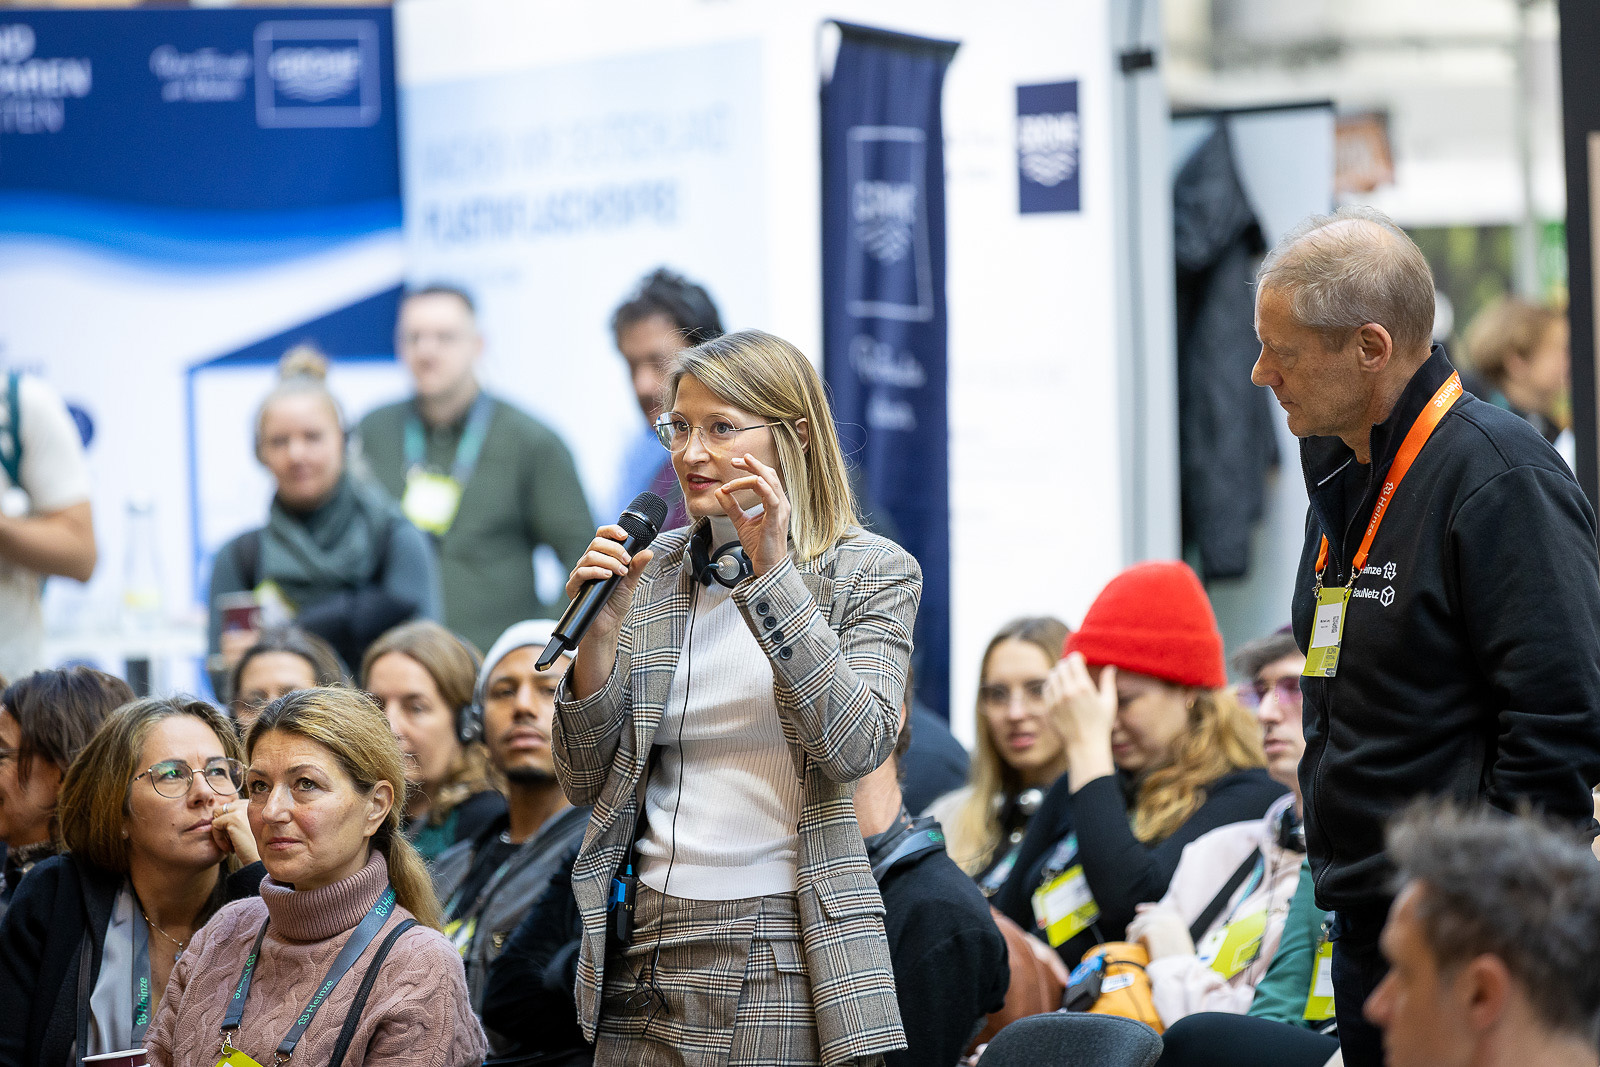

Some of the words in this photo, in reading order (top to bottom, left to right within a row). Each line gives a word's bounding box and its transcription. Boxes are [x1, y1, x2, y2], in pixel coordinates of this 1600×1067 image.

[1434, 379, 1460, 407] Heinze
[1367, 497, 1386, 535] Heinze
[1363, 564, 1382, 575] einze
[138, 977, 148, 1012] Heinze
[306, 981, 333, 1012] Heinze
